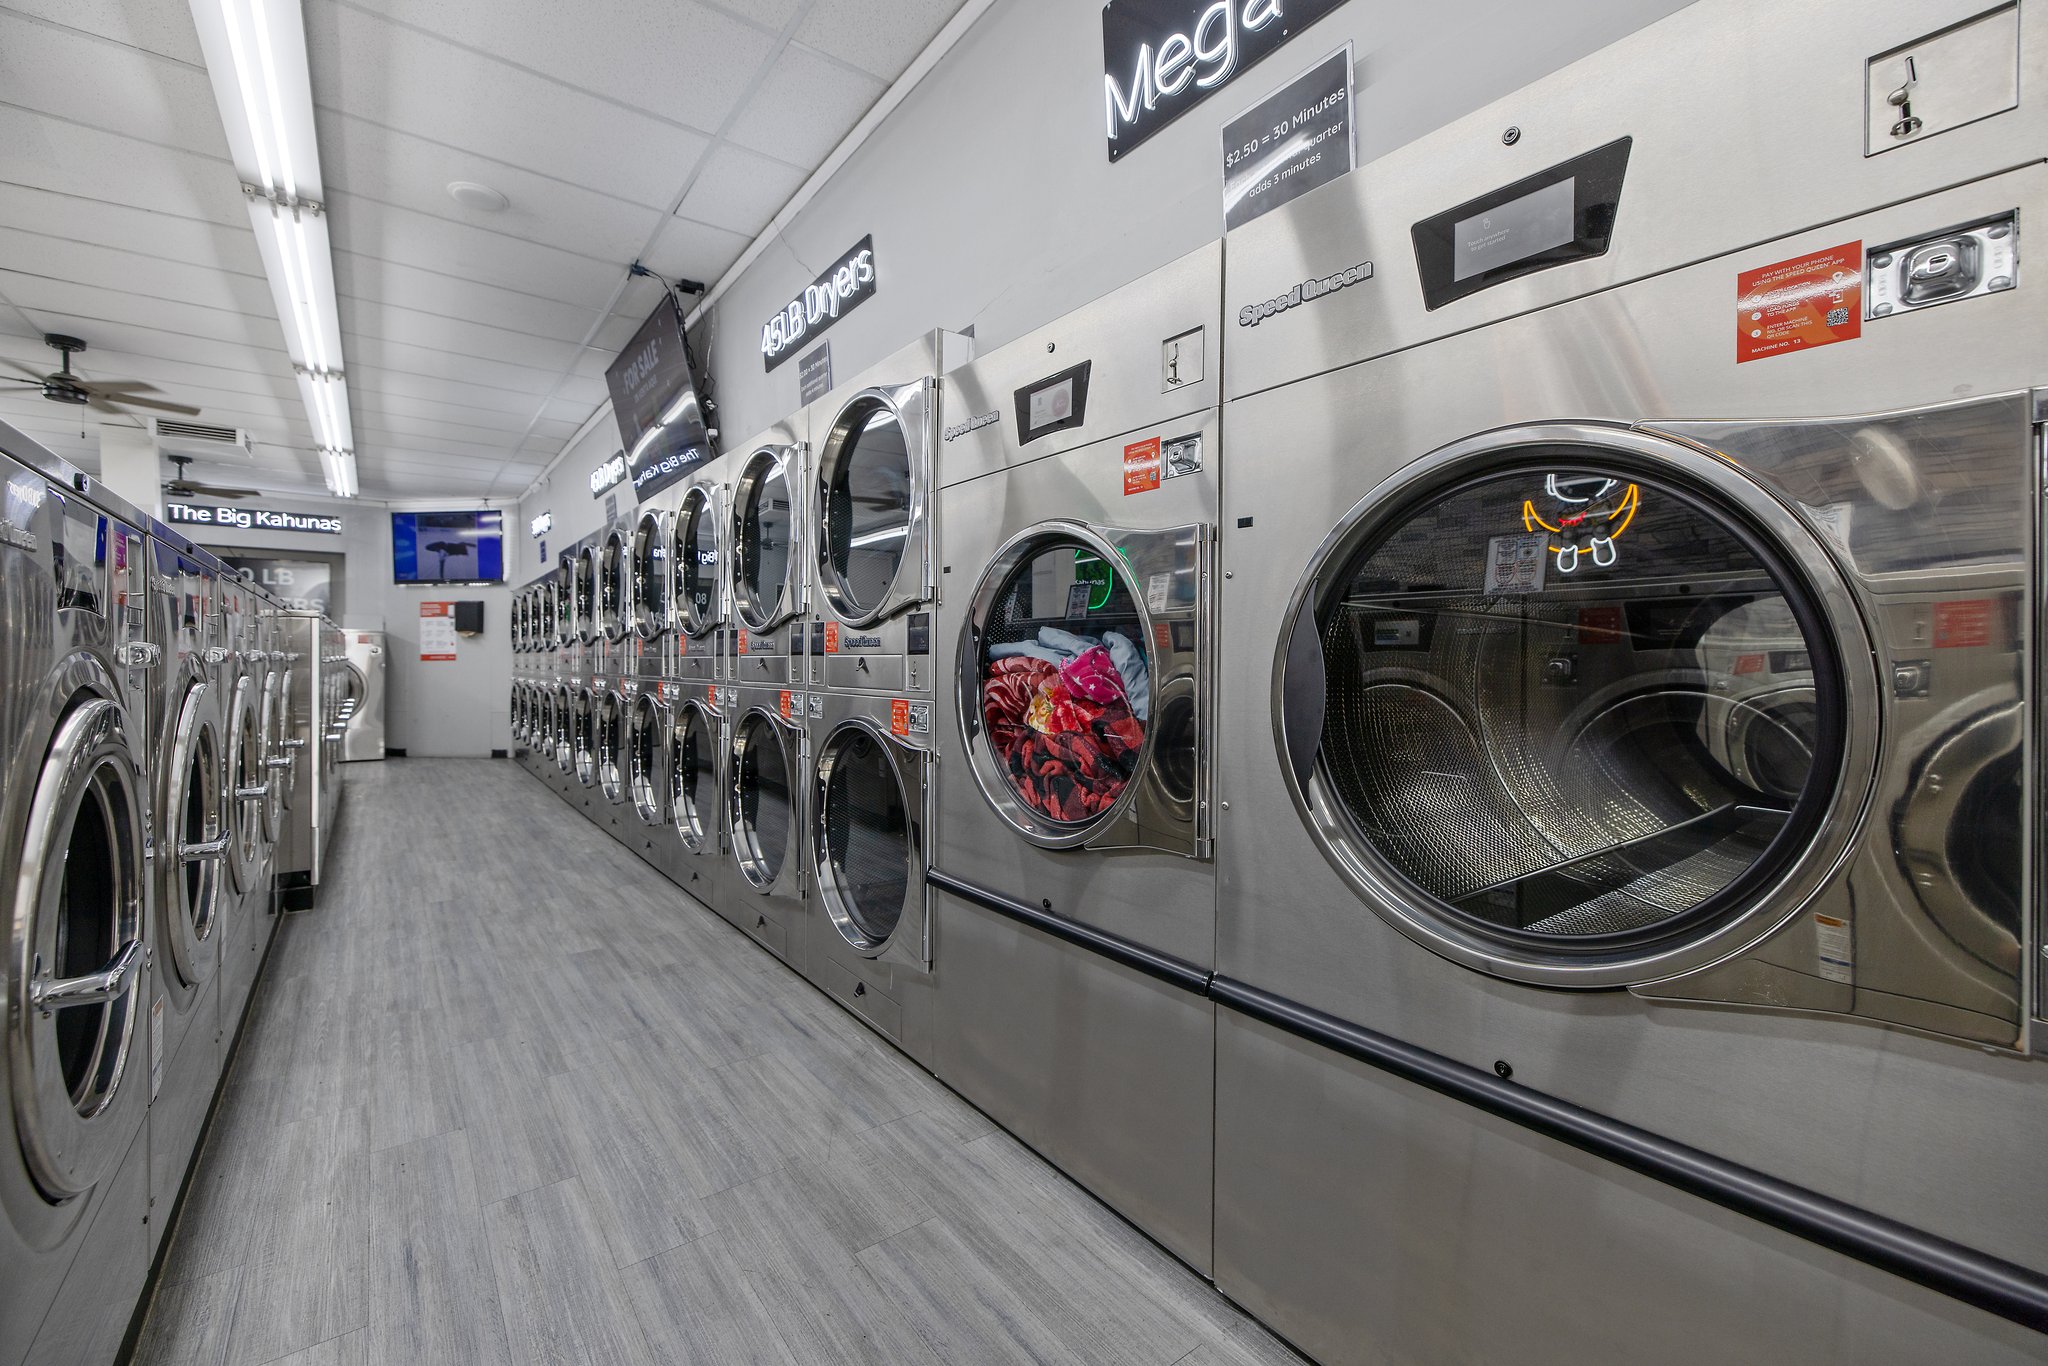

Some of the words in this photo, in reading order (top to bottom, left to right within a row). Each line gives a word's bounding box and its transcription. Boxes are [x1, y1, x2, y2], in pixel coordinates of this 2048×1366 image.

[1226, 139, 1259, 168] $2.50
[1273, 120, 1289, 140] 30
[1292, 87, 1345, 129] Minutes
[1249, 179, 1272, 198] adds
[1274, 174, 1280, 185] 3
[1281, 152, 1322, 180] minutes
[1468, 237, 1484, 247] Touch
[1752, 278, 1772, 287] USING
[1772, 274, 1785, 282] THE
[1785, 270, 1805, 279] SPEED
[1831, 258, 1845, 266] APP
[1761, 271, 1774, 279] PAY
[1774, 267, 1791, 276] WITH
[1791, 262, 1810, 270] YOUR
[1810, 255, 1834, 266] PHONE
[804, 250, 874, 325] Dryers
[1239, 284, 1302, 327] Speed
[1301, 261, 1373, 302] Queen
[1751, 343, 1778, 354] MACHINE
[623, 361, 638, 396] FOR
[638, 338, 659, 378] SALE
[944, 418, 972, 442] Speed
[971, 410, 1000, 431] Queen
[168, 503, 211, 521] The
[217, 508, 251, 528] Big
[256, 511, 342, 531] Kahunas
[262, 568, 295, 585] LB
